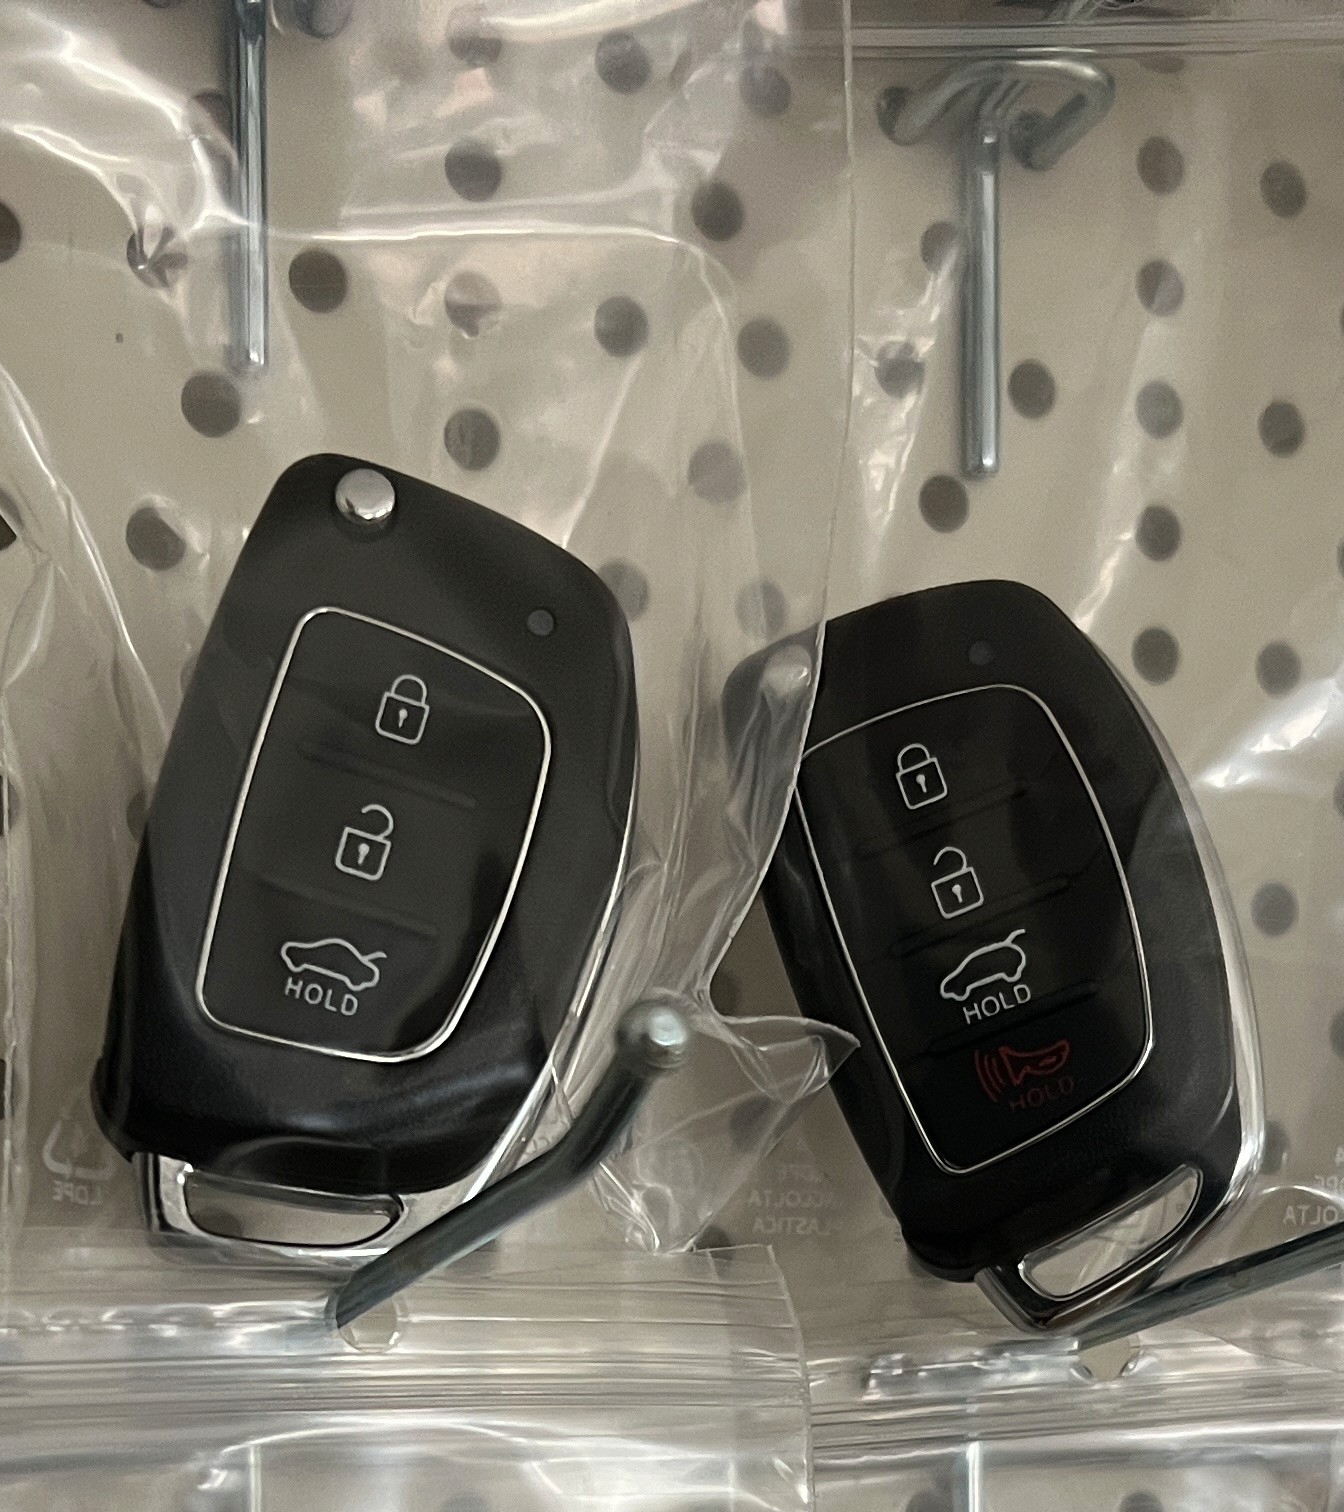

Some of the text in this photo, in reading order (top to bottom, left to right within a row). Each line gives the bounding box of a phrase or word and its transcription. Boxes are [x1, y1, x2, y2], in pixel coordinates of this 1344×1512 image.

[284, 976, 359, 1016] HOLD
[962, 984, 1032, 1025] HOLD
[1008, 1075, 1075, 1112] HOLD
